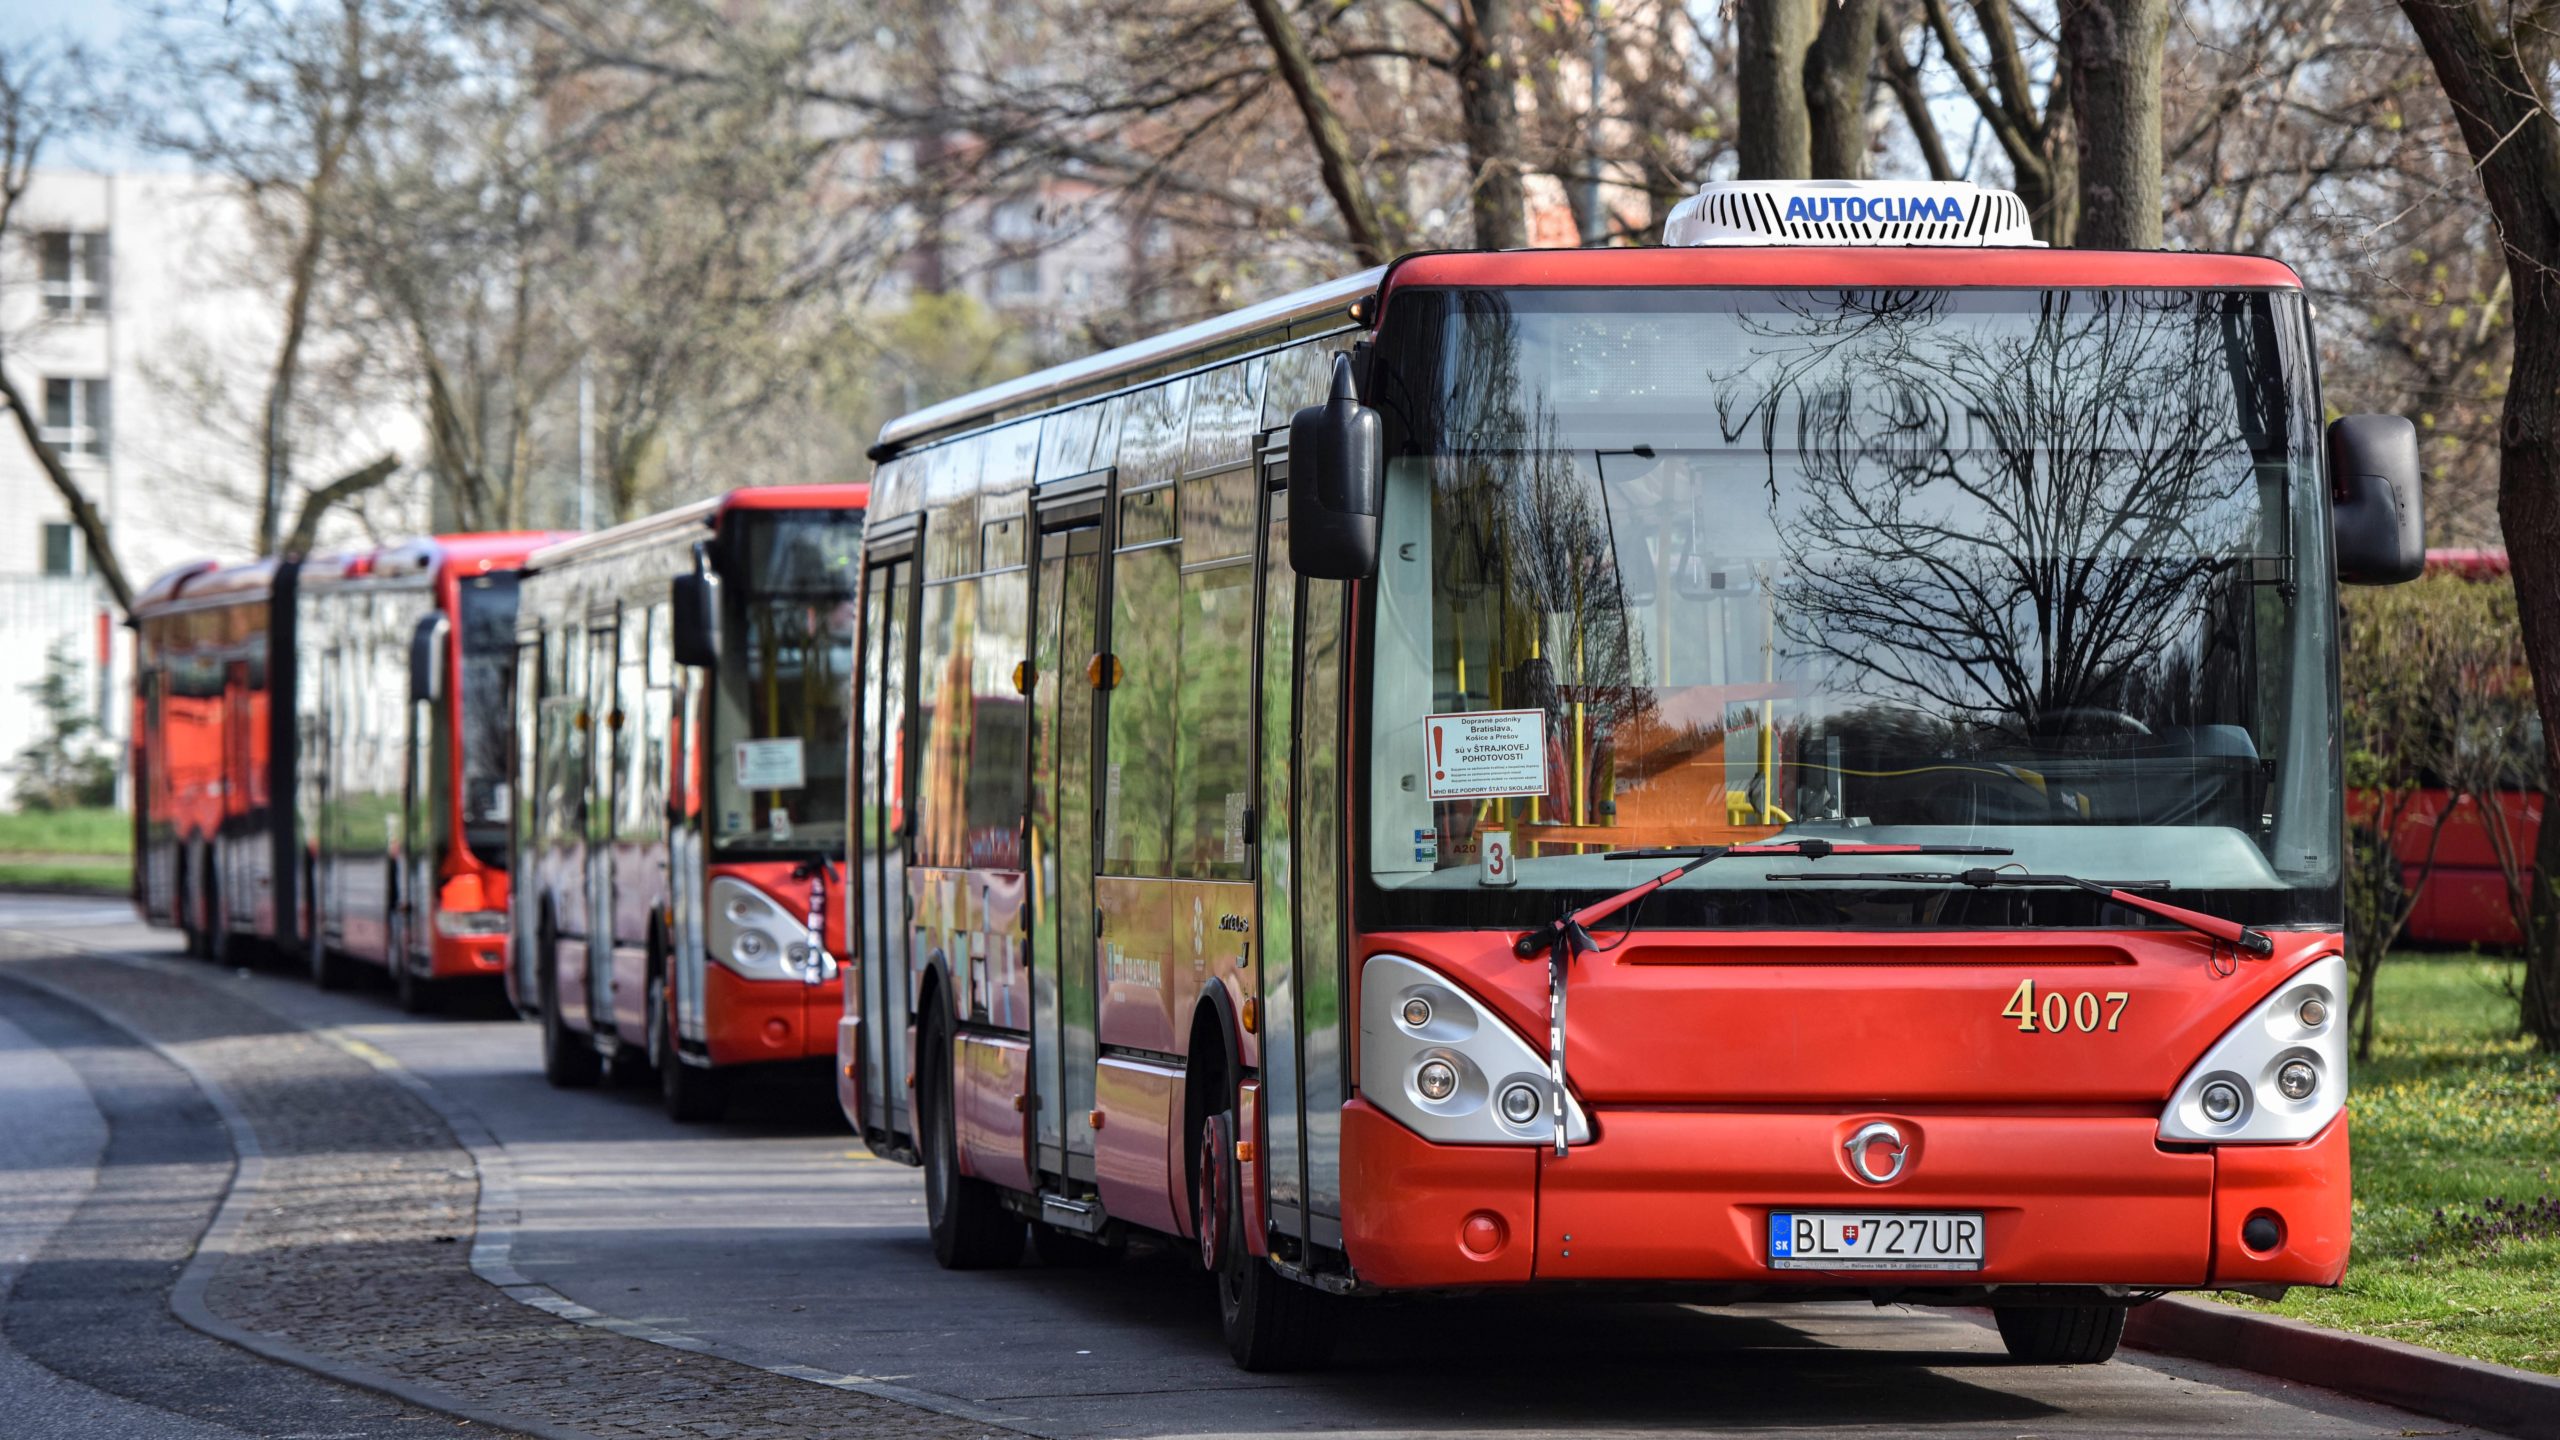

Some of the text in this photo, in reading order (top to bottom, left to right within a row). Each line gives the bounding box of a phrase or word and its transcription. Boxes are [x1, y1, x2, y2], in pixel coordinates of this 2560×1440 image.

[1784, 196, 1965, 223] AUTOCLIMA
[1494, 716, 1521, 724] podniky
[1470, 725, 1513, 733] Bratislava,
[1455, 746, 1465, 754] sú
[1473, 743, 1530, 753] ŠTRAJKOVEJ
[1462, 753, 1523, 763] POHOTOVOSTI
[1453, 844, 1477, 854] A20
[1489, 842, 1504, 875] 3
[2001, 979, 2129, 1033] 4007
[1775, 1219, 1976, 1254] SK BL 727UR
